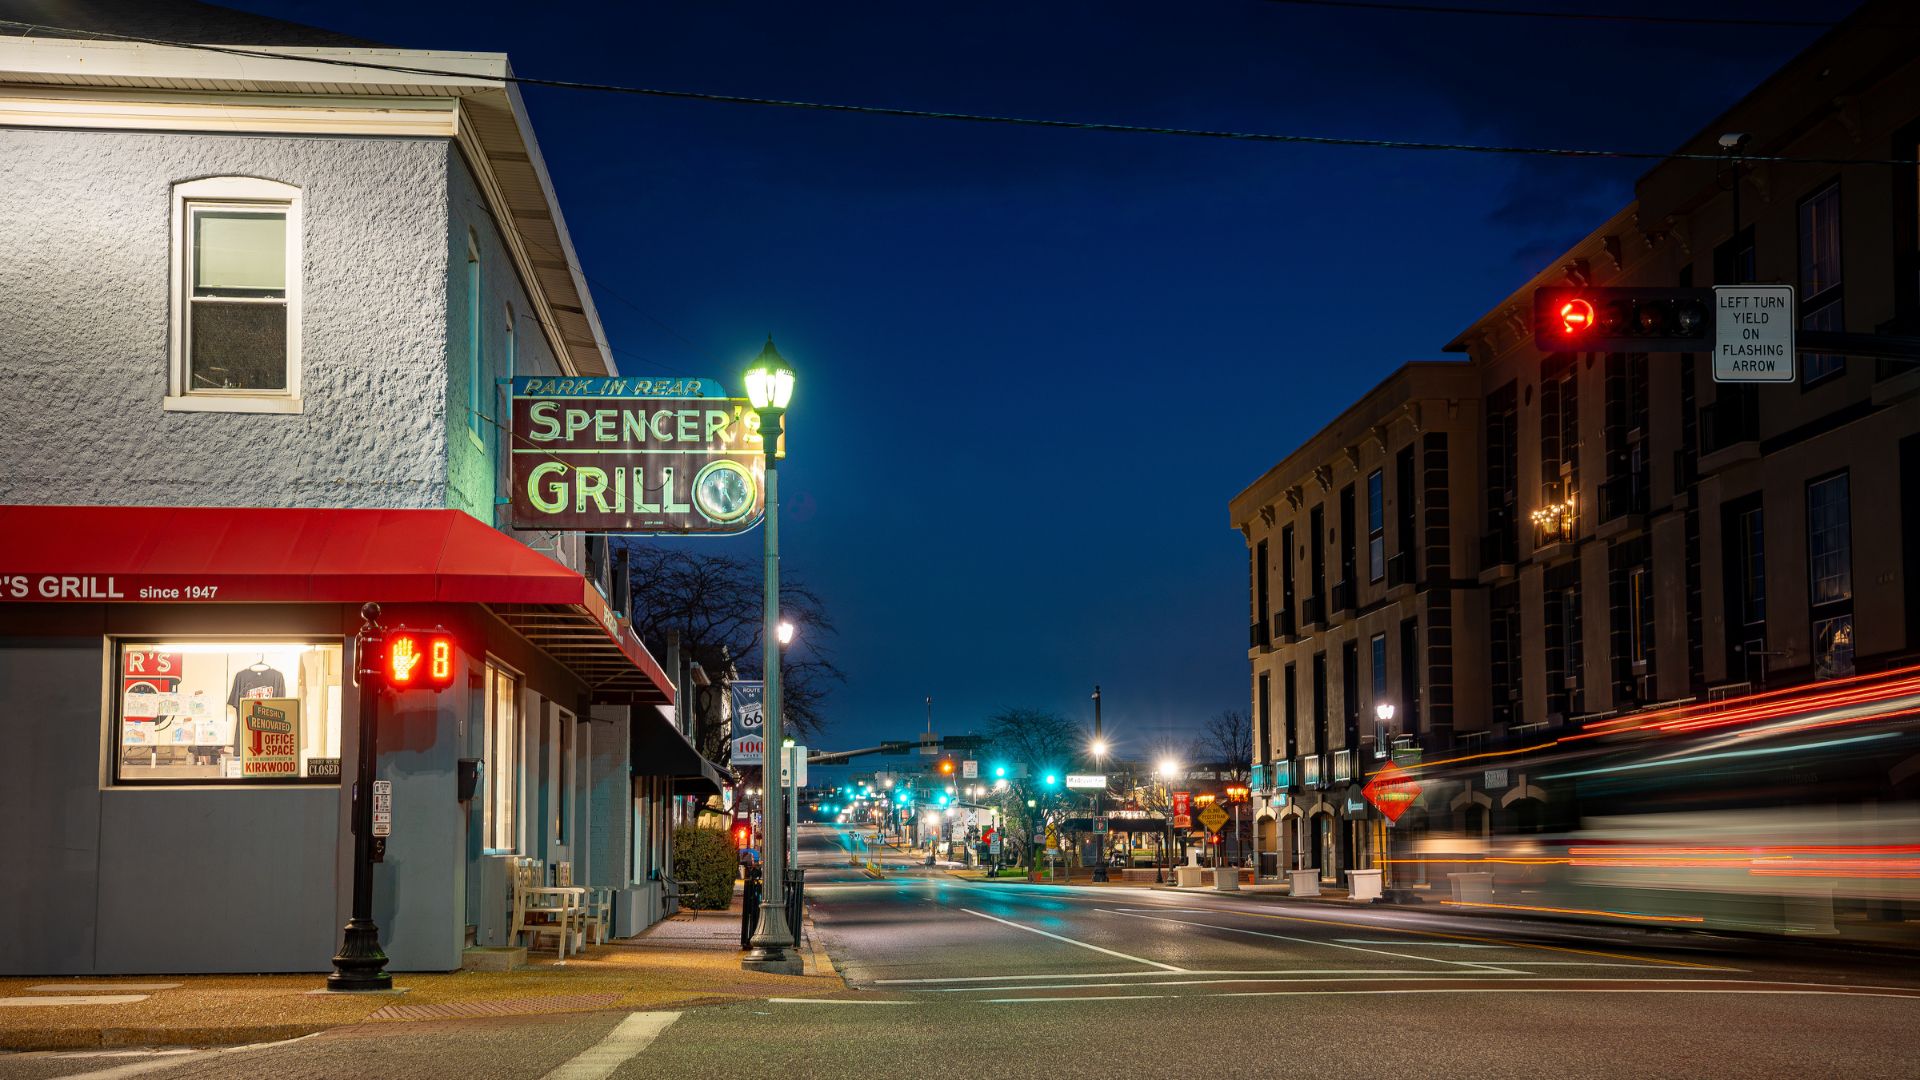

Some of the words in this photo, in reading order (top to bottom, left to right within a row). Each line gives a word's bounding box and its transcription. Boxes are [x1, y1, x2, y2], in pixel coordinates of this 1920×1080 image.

[1720, 296, 1750, 308] LEFT
[1753, 296, 1785, 308] TURN
[1733, 312, 1769, 324] YIELD
[1742, 328, 1760, 340] ON
[1723, 344, 1784, 356] FLASHING
[1732, 360, 1776, 372] ARROW
[523, 379, 593, 395] PARK
[600, 380, 630, 395] IN
[633, 380, 702, 396] REAR
[529, 401, 761, 442] SPENCER'S
[527, 461, 691, 514] GRILL
[38, 576, 124, 598] GRILL
[139, 586, 179, 598] since
[184, 586, 218, 598] 1947
[257, 706, 284, 719] FRESHLY
[251, 716, 291, 732] RENOVATED
[743, 711, 763, 727] 66
[264, 733, 295, 745] OFFICE
[265, 744, 295, 756] SPACE
[245, 761, 296, 773] KIRKWOOD
[309, 764, 340, 775] CLOSED
